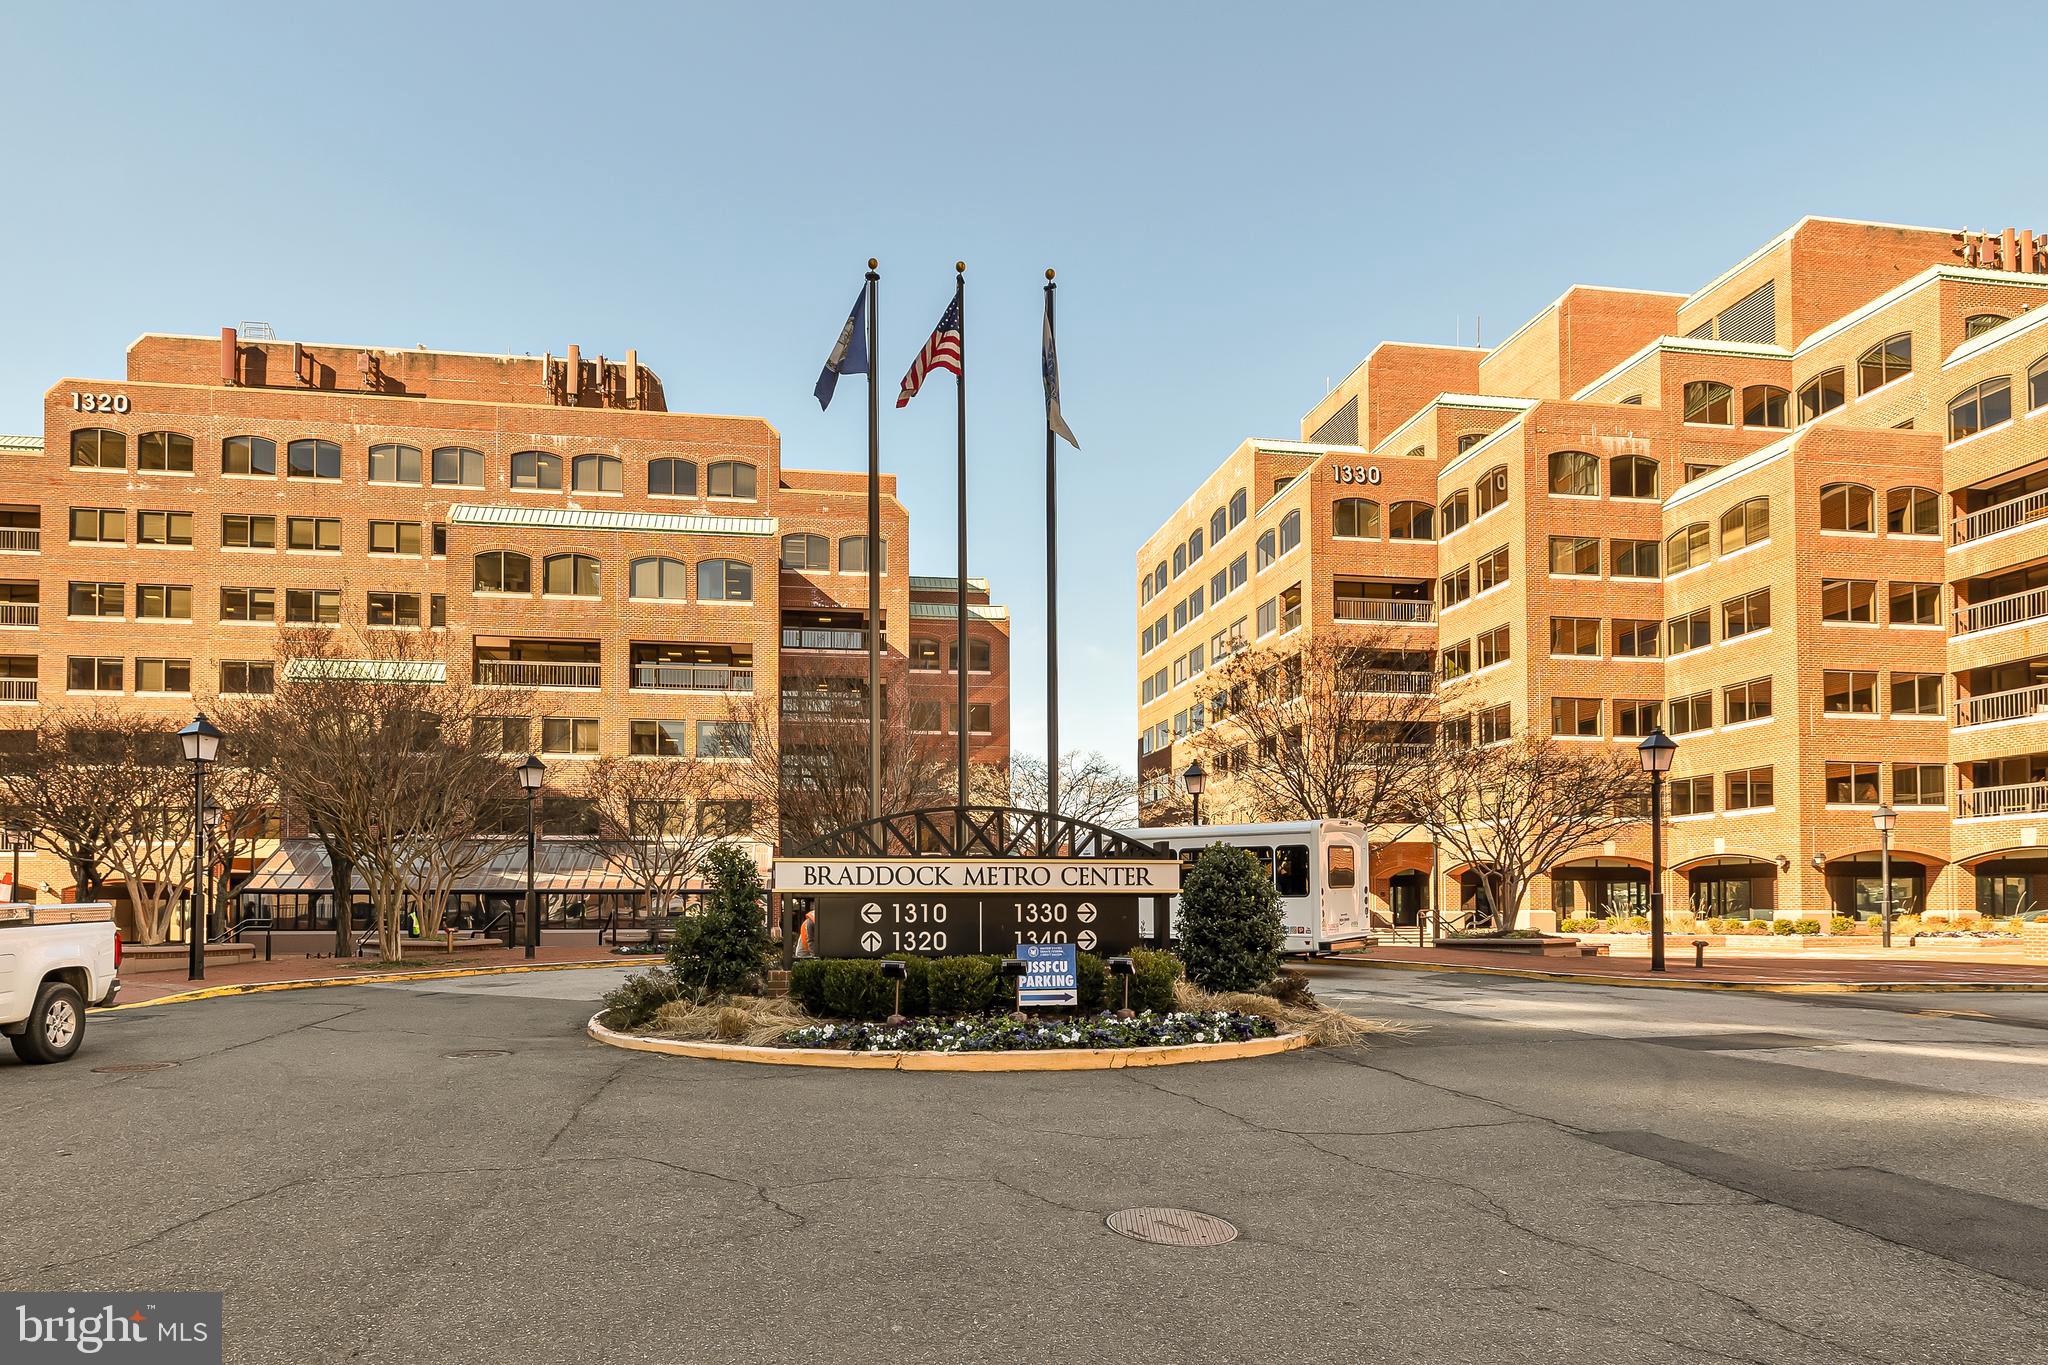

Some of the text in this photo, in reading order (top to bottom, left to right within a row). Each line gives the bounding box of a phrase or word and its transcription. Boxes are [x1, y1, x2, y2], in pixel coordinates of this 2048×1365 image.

[70, 392, 129, 413] 1320
[1332, 464, 1380, 484] 1330
[803, 865, 1154, 886] BRADDOCK METRO CENTER
[892, 903, 947, 923] 1310
[1014, 903, 1068, 923] 1330
[892, 931, 947, 951] 1320
[1014, 930, 1068, 944] 1340
[1018, 974, 1074, 988] PARKING
